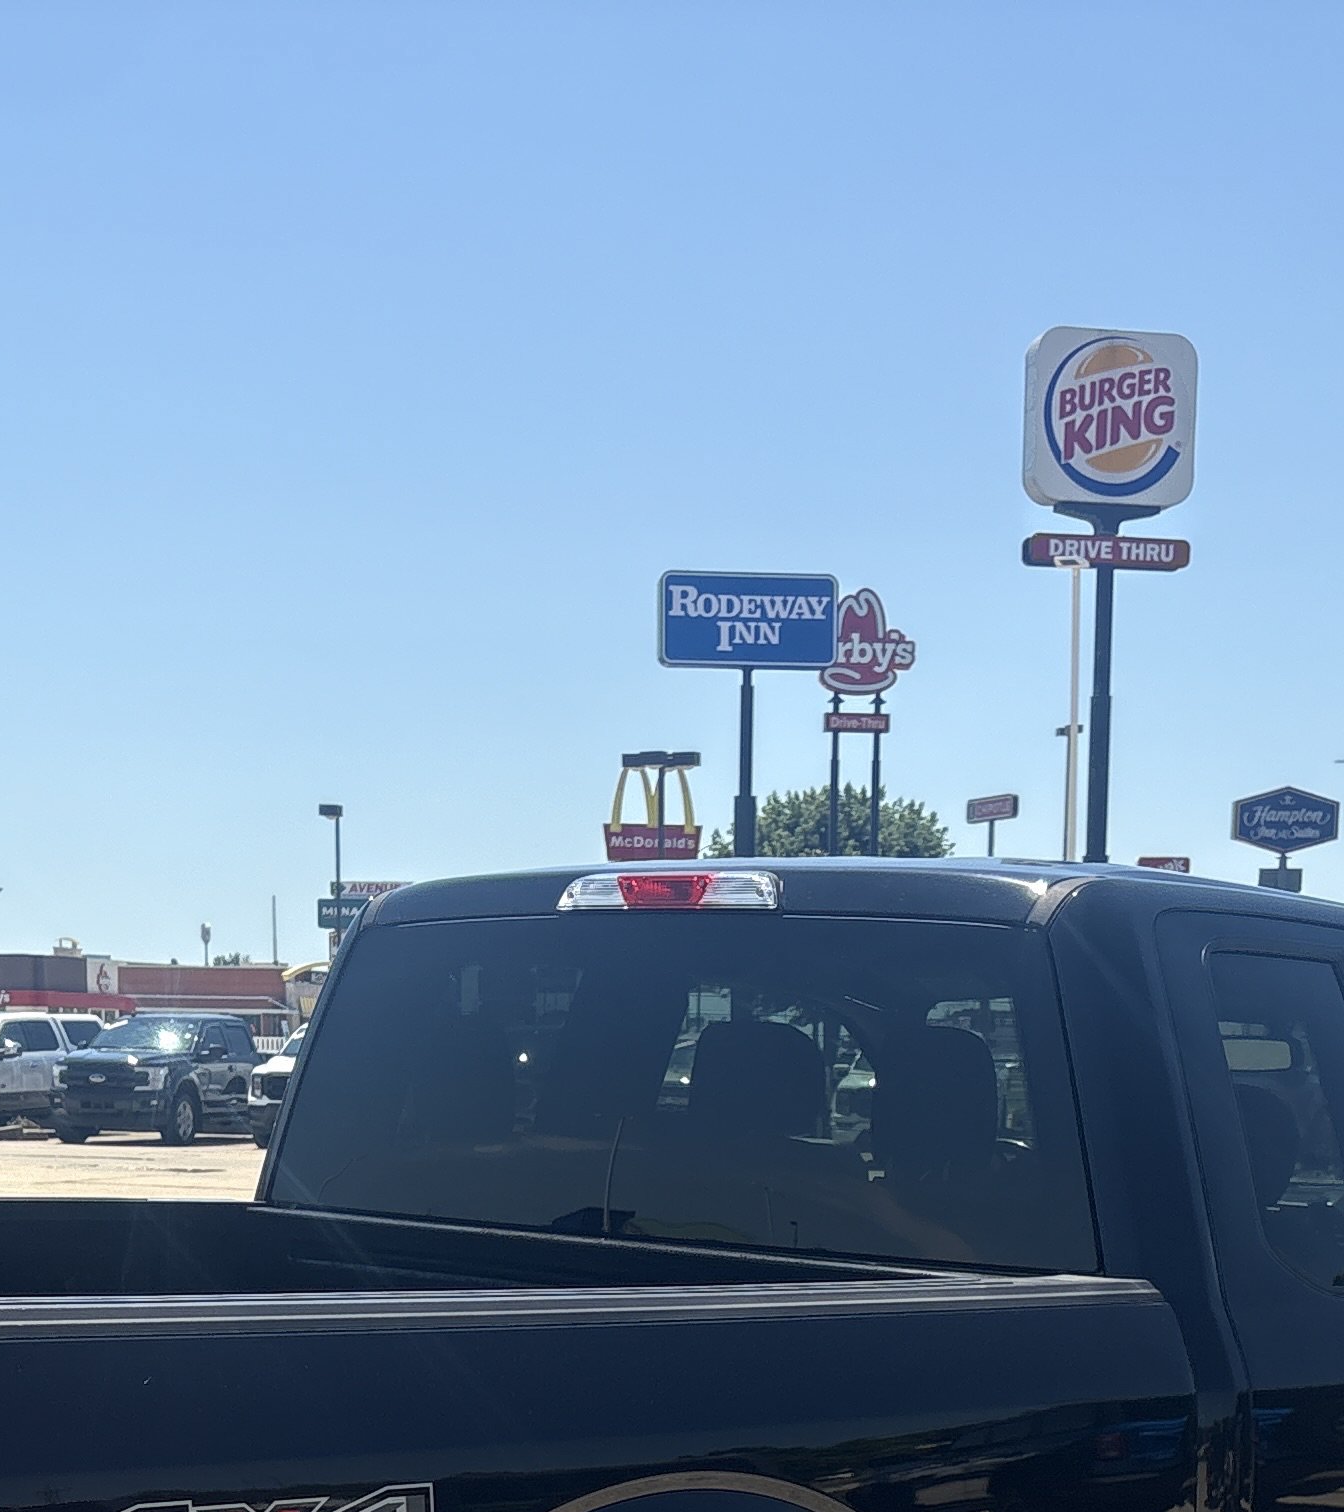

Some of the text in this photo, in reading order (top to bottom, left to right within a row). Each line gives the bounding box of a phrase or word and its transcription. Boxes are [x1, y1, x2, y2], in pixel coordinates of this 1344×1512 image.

[1059, 367, 1172, 420] BURGER
[1063, 395, 1175, 461] KING
[1049, 538, 1175, 563] DRIVE THRU
[668, 584, 831, 620] RODEWAY
[716, 620, 782, 652] INN
[838, 632, 914, 672] rby's
[830, 716, 886, 729] Drive-Thru
[1243, 804, 1331, 827] Hampton
[609, 835, 695, 849] McDoald's
